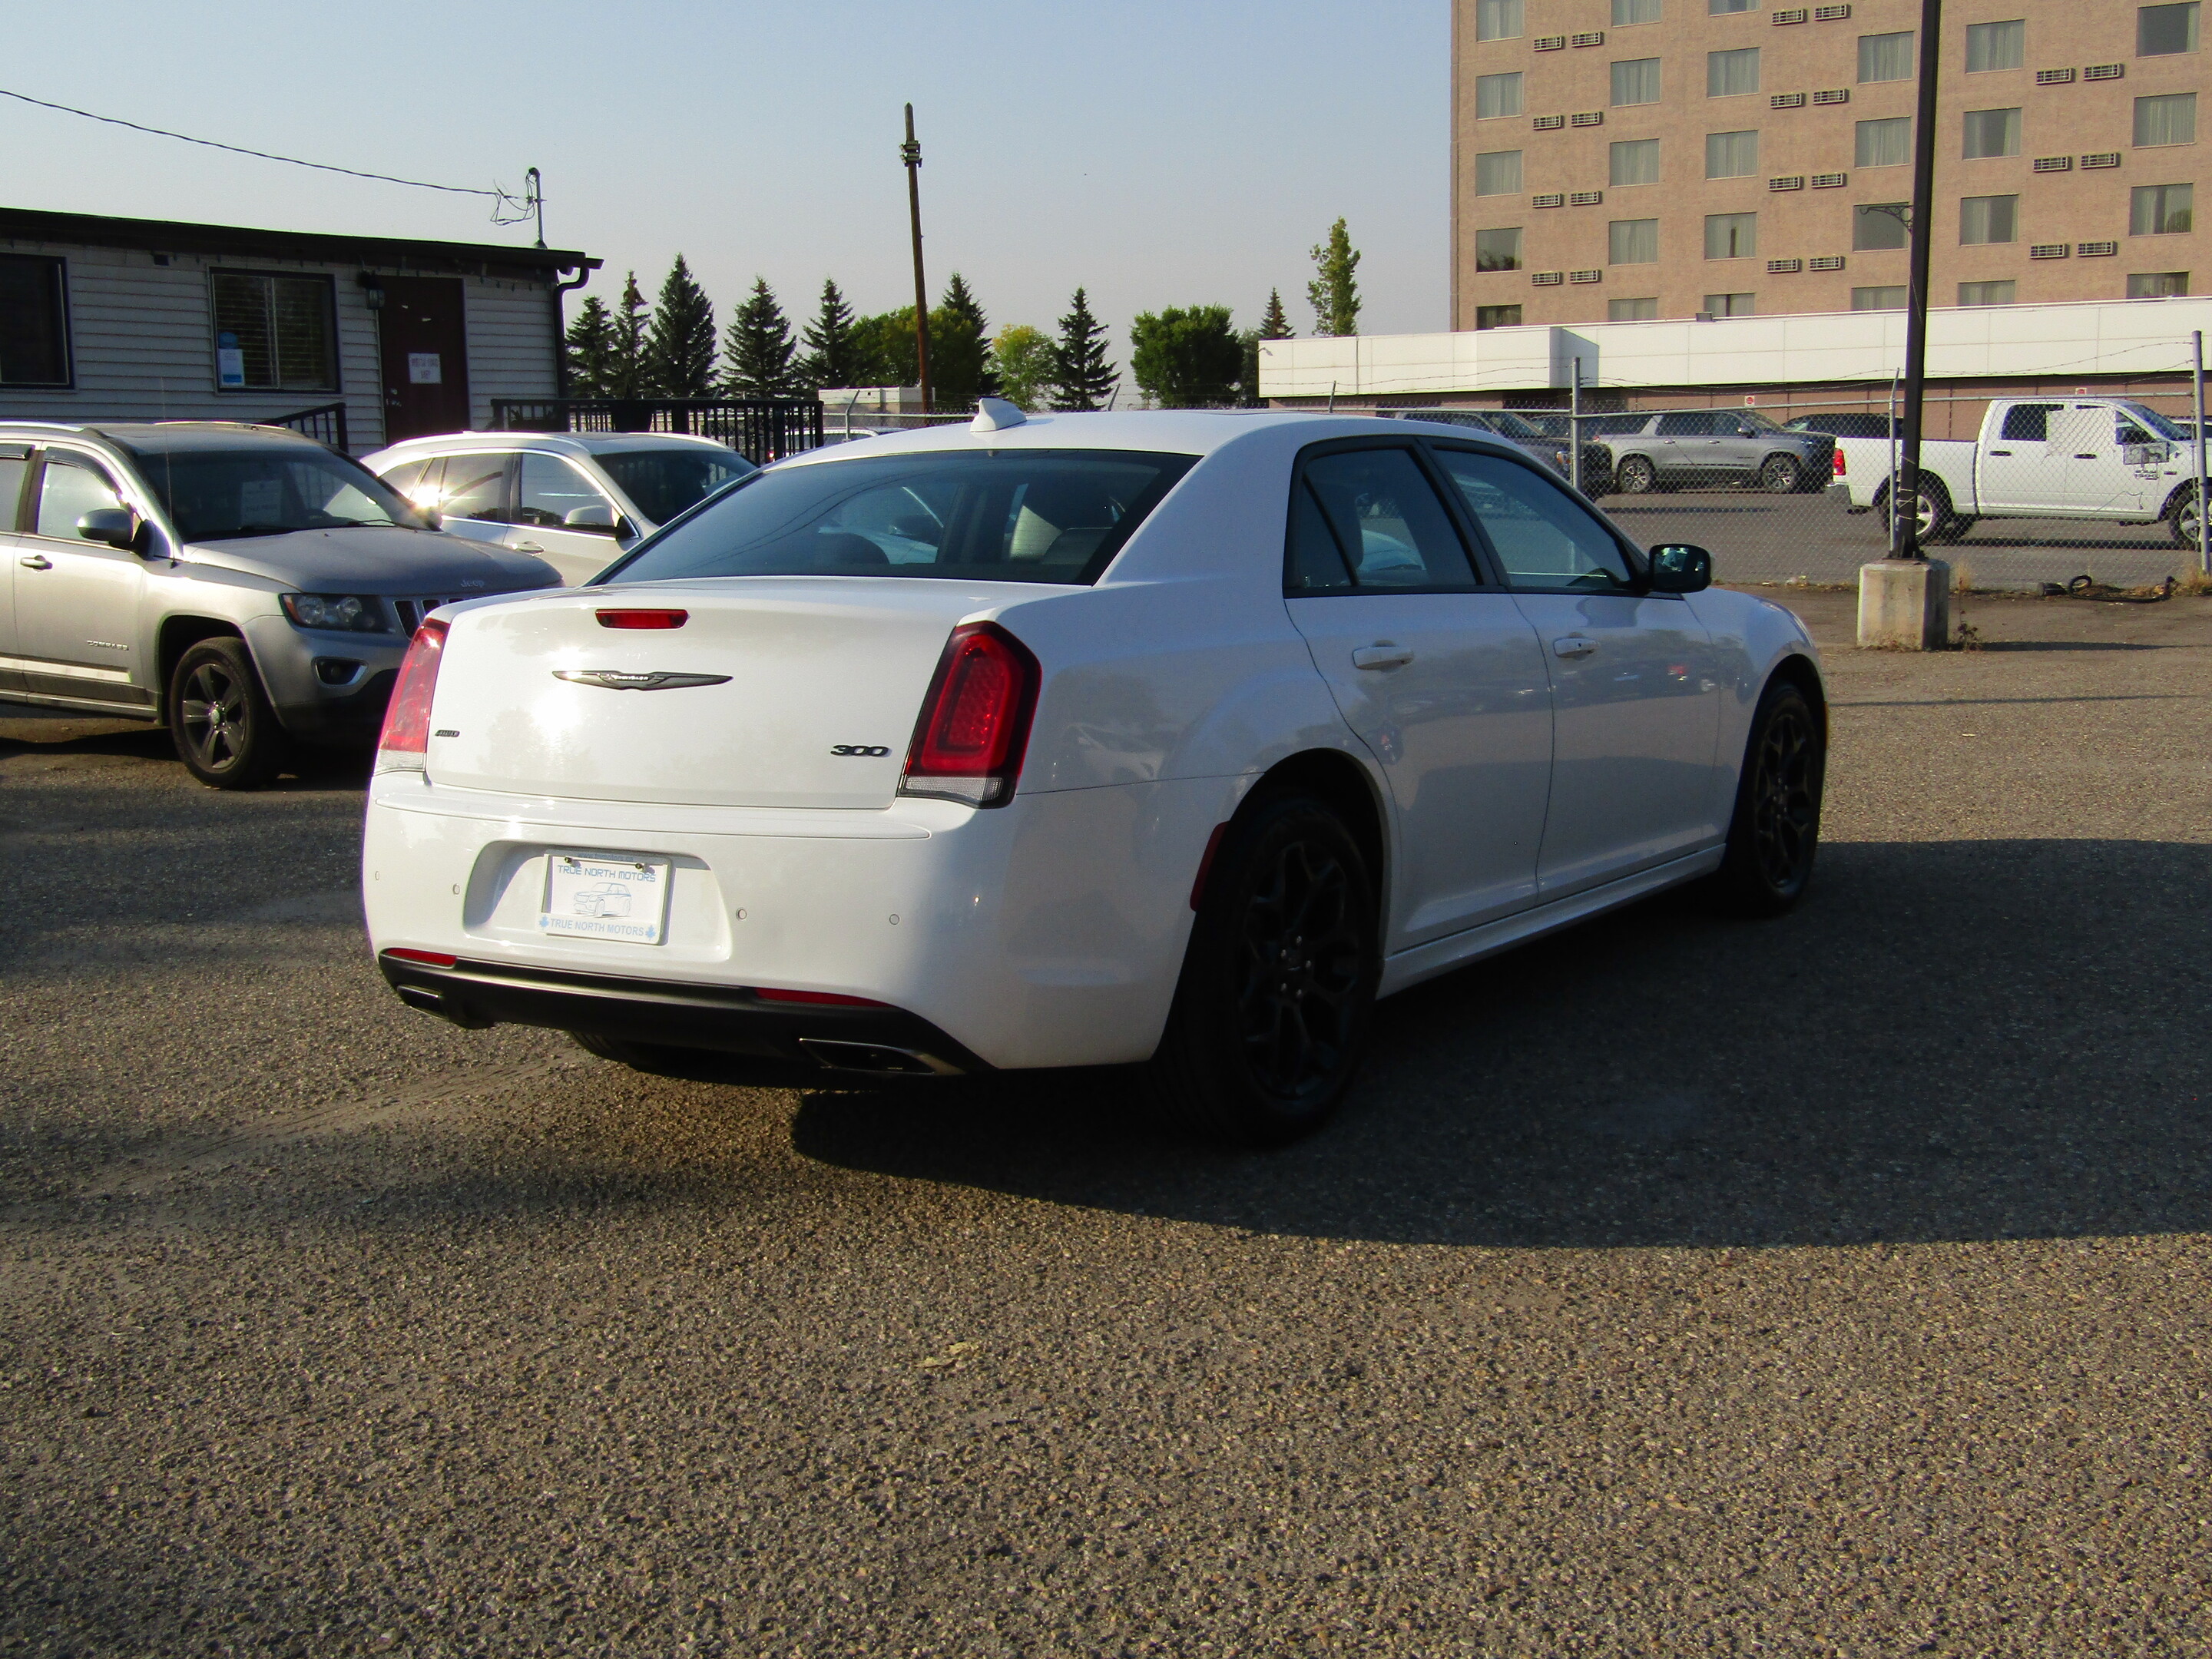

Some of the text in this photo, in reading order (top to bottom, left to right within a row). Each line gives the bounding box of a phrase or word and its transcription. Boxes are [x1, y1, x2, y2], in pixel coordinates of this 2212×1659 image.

[830, 744, 889, 757] 300
[558, 865, 657, 882] TRUE NORTH MOTORS
[551, 919, 644, 936] TRUE NORTH MOTORS
